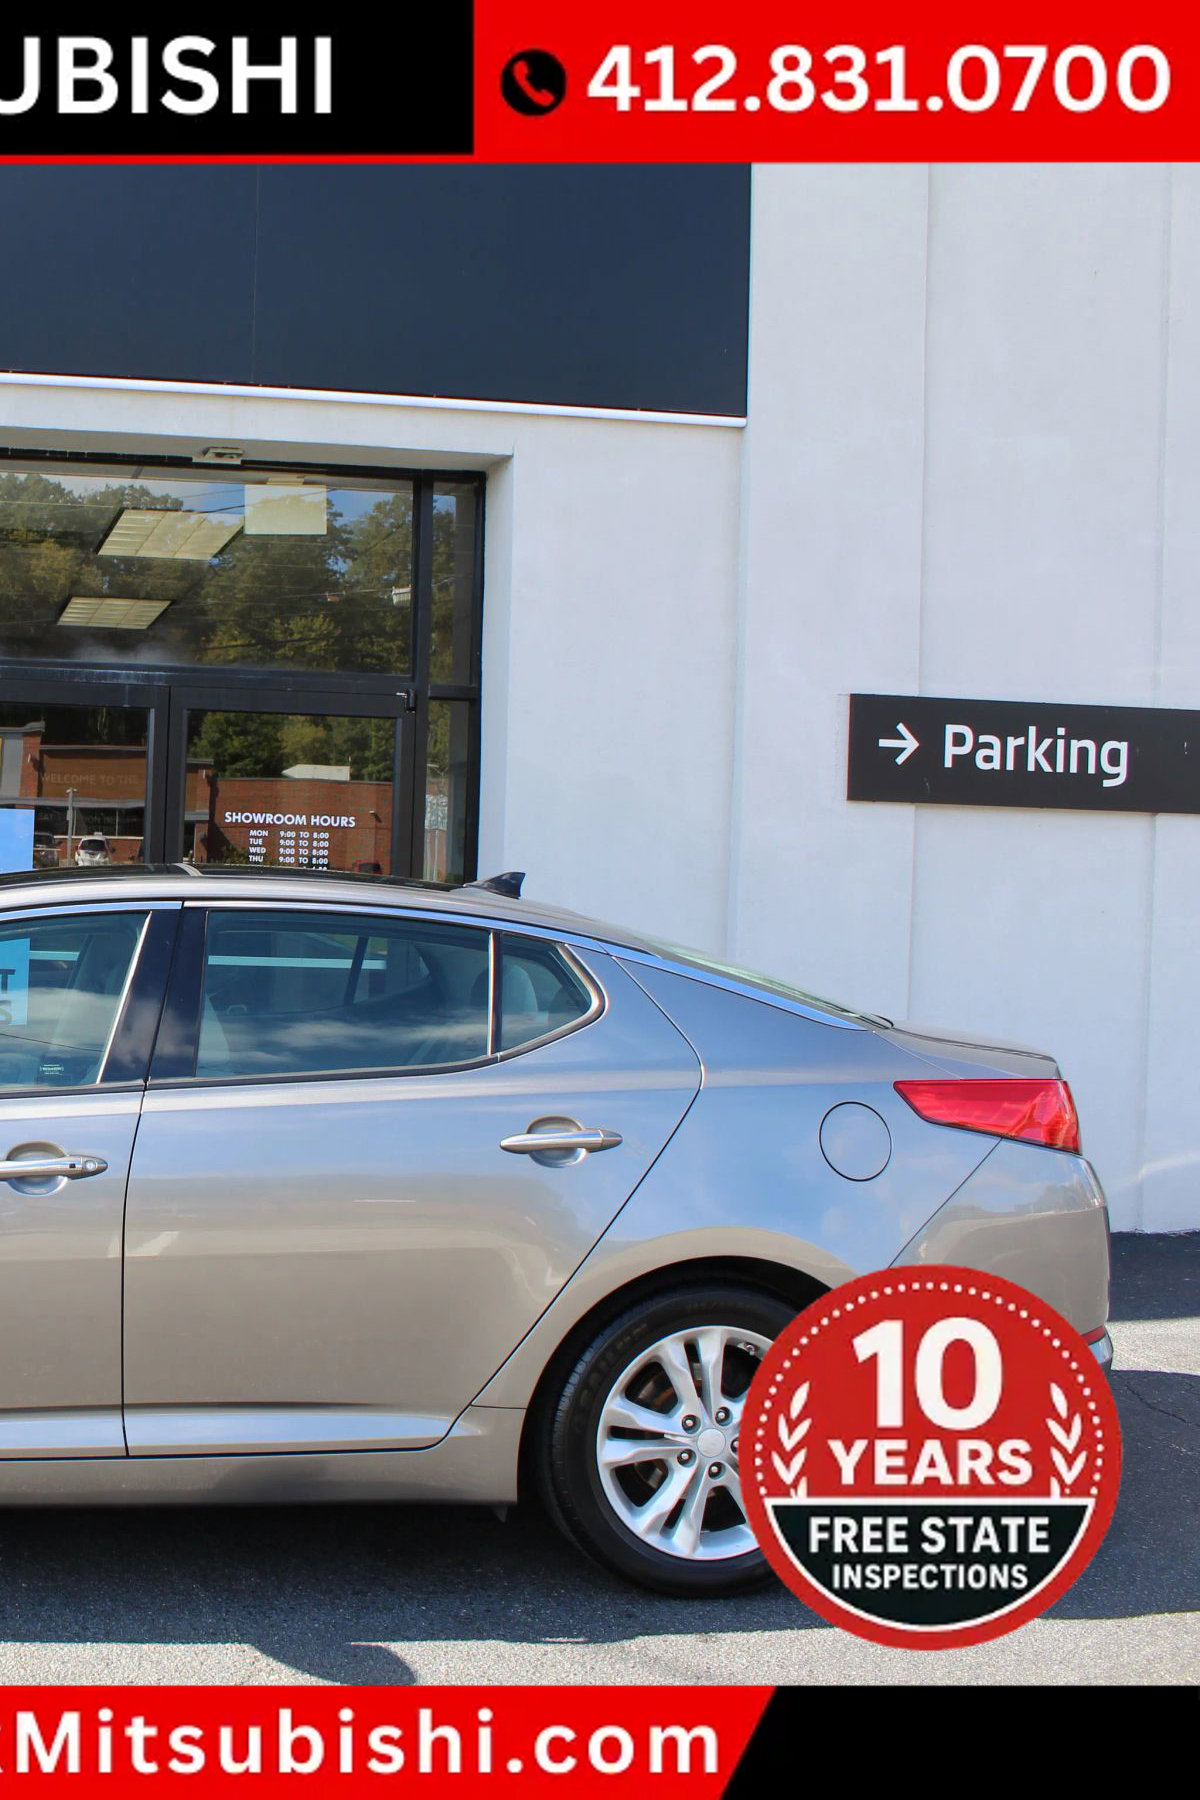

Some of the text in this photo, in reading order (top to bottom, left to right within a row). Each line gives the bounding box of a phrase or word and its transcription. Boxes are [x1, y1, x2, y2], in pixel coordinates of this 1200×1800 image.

[944, 723, 1129, 788] Parking
[224, 811, 356, 828] SHOWROOM HOURS
[249, 829, 269, 837] MON
[280, 830, 296, 838] 9:00
[299, 831, 310, 839] TO
[249, 838, 263, 846] TUE
